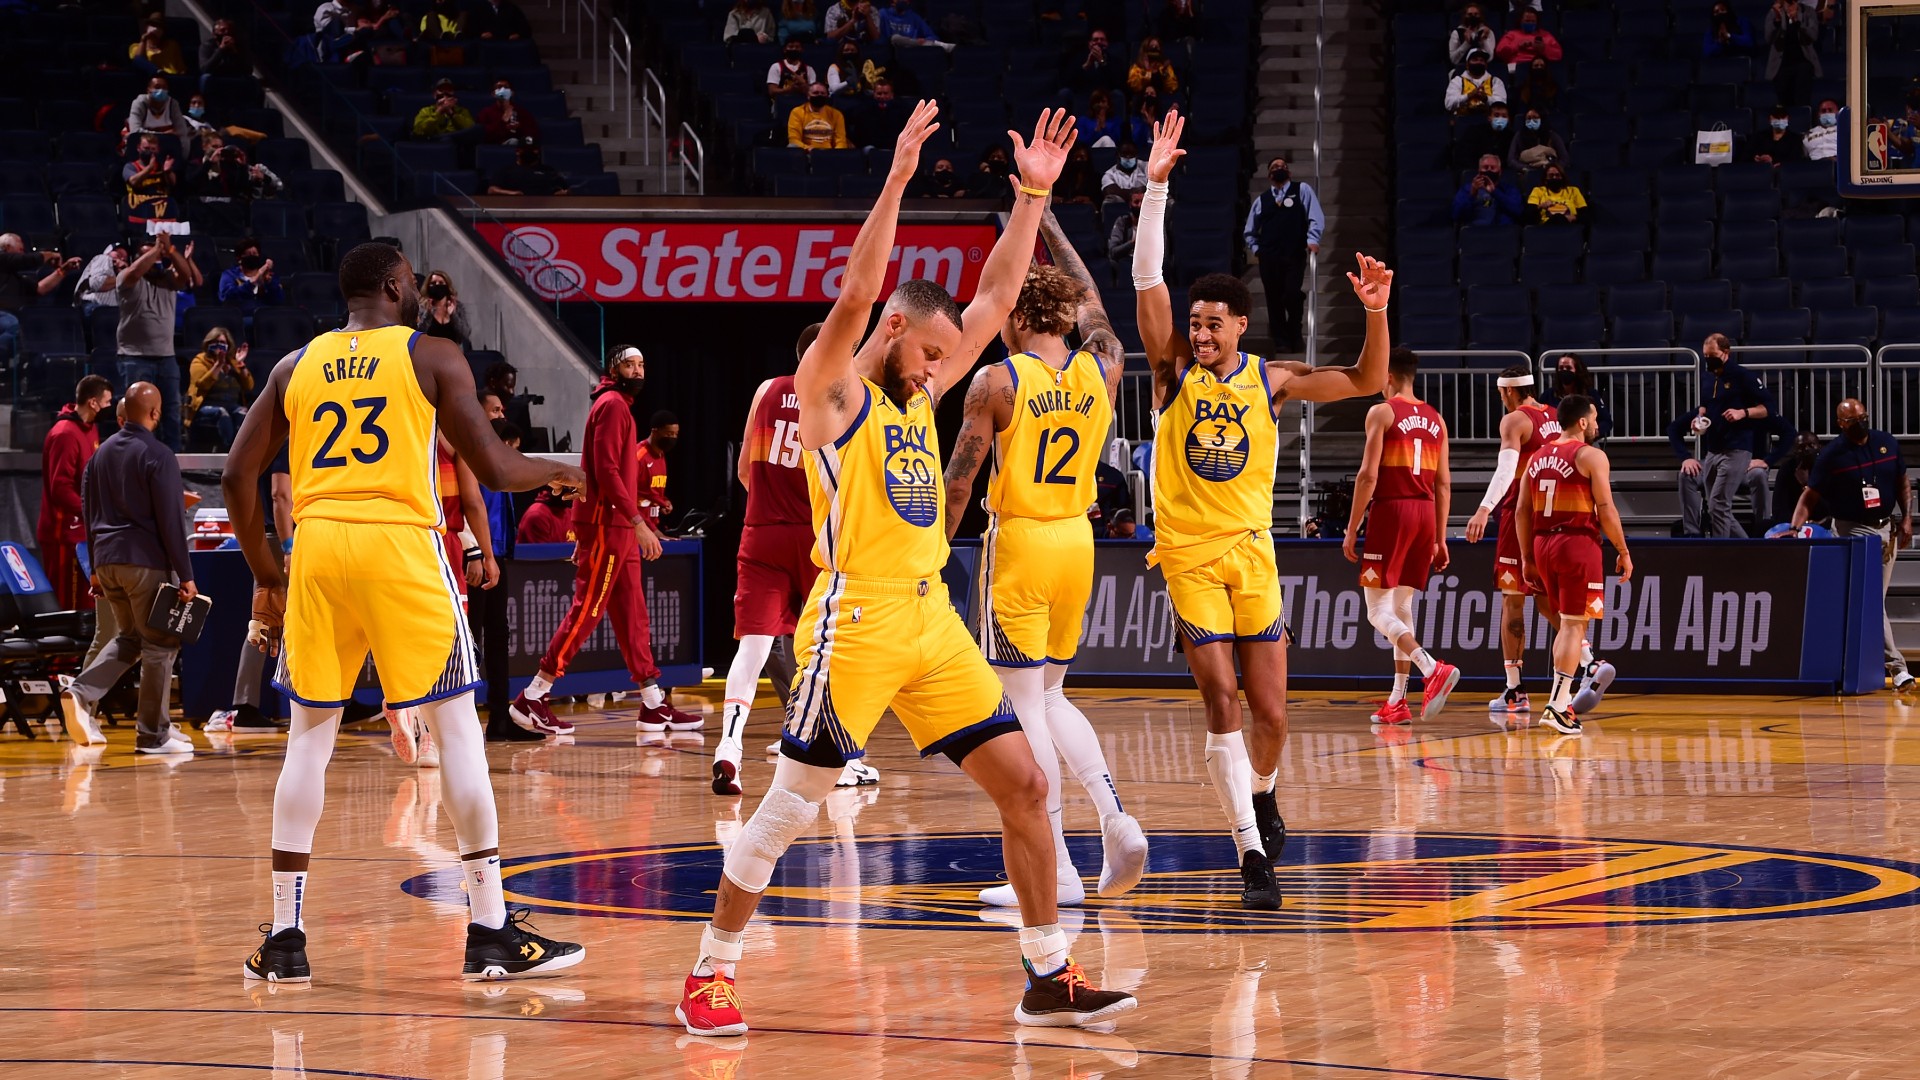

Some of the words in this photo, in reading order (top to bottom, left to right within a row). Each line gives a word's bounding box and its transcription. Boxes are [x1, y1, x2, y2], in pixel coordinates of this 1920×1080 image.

[1860, 176, 1893, 185] SPALDING
[787, 229, 964, 299] Fam
[322, 356, 380, 383] GREEN
[1028, 390, 1071, 418] OUBRE
[1075, 393, 1095, 418] JR.
[1215, 392, 1231, 402] The
[1195, 399, 1251, 424] BAY
[1397, 415, 1428, 435] PORTER
[312, 396, 389, 469] 23
[768, 419, 803, 468] 15
[884, 424, 927, 452] BAY
[1211, 424, 1227, 447] 3
[1033, 426, 1080, 485] 12
[1413, 438, 1422, 476] 1
[899, 457, 931, 485] 30
[1539, 479, 1557, 517] 7
[591, 554, 615, 618] NUGGETS
[1278, 575, 1360, 649] The
[1585, 575, 1661, 651] BA
[1674, 575, 1772, 666] App
